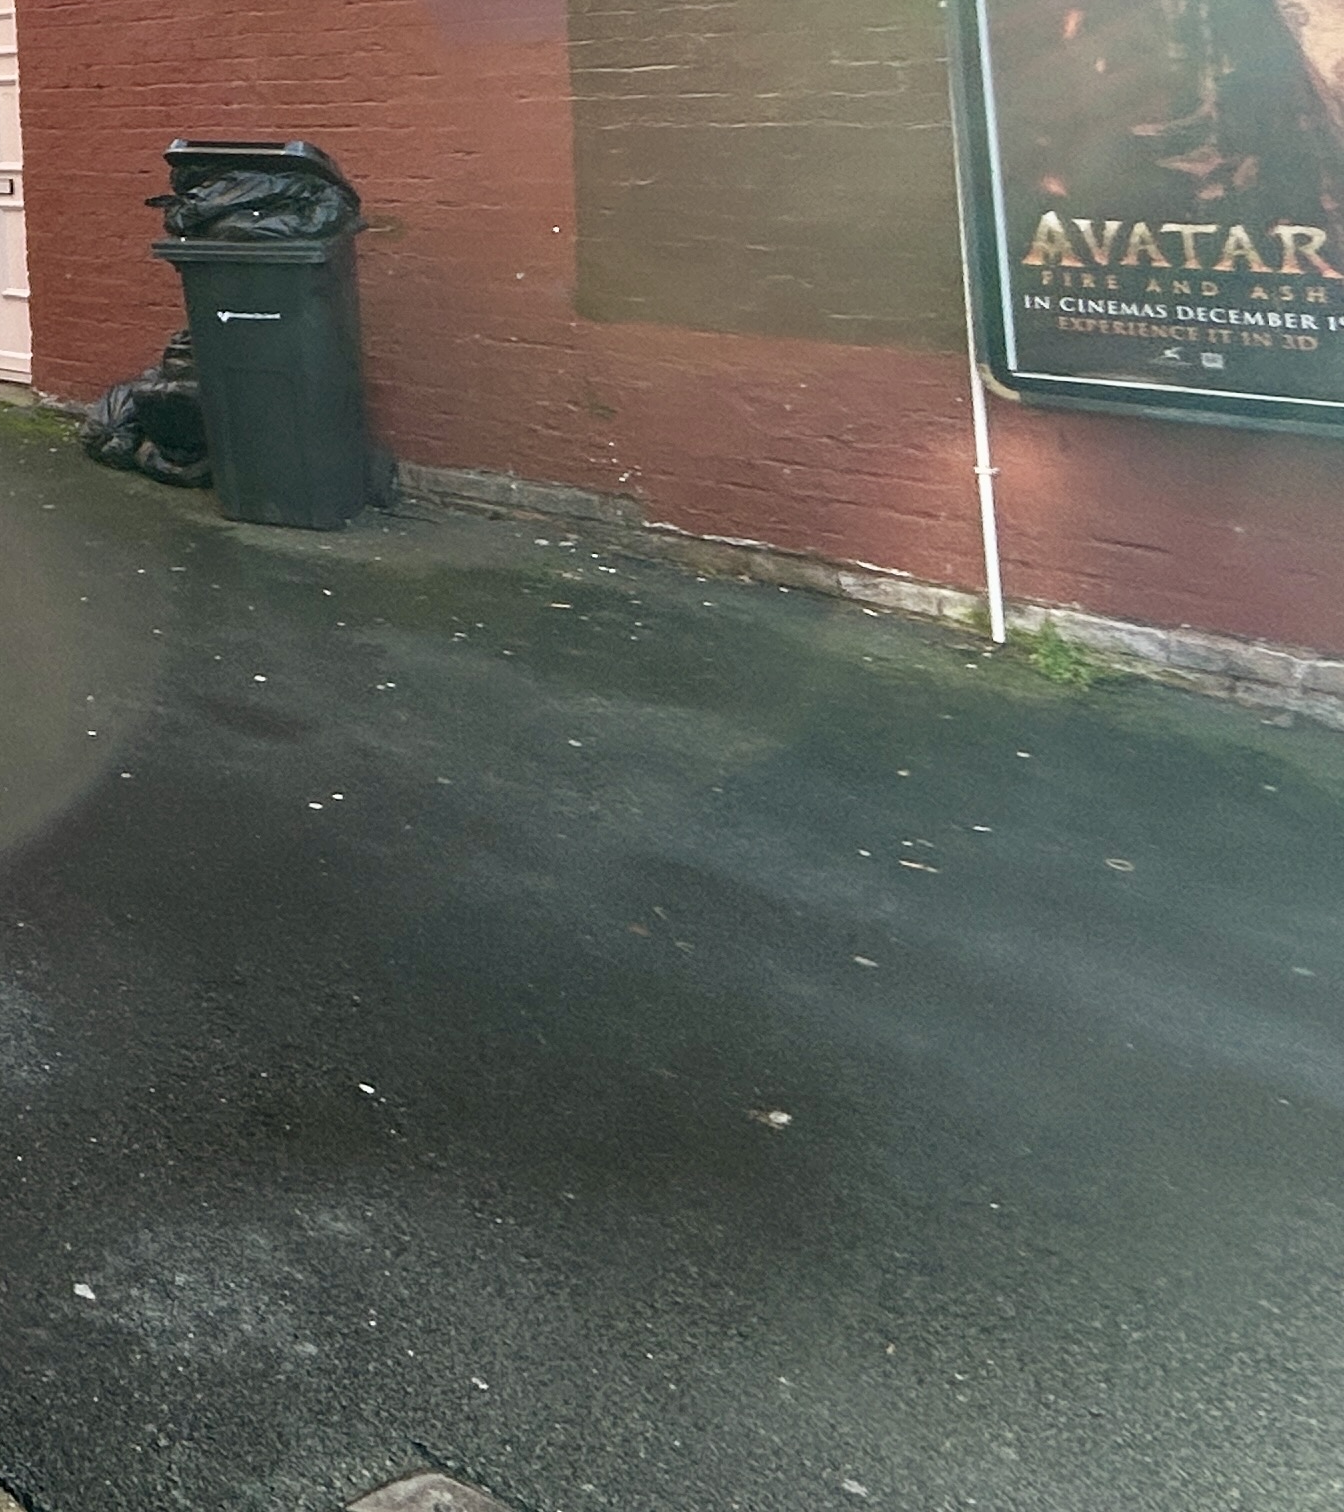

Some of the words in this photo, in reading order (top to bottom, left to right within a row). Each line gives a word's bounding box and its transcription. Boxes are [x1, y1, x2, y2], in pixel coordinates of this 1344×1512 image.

[1021, 209, 1344, 280] AVATAR
[1040, 270, 1120, 290] FIRE
[1145, 279, 1220, 297] AND
[1249, 285, 1329, 304] ASH
[1023, 294, 1051, 311] IN
[1058, 297, 1168, 320] CINEMAS
[1175, 304, 1320, 331] DECEMBER
[1058, 315, 1198, 342] EXPERIENCE
[1208, 328, 1233, 344] IT
[1240, 331, 1273, 348] IN
[1281, 333, 1320, 352] 3D
